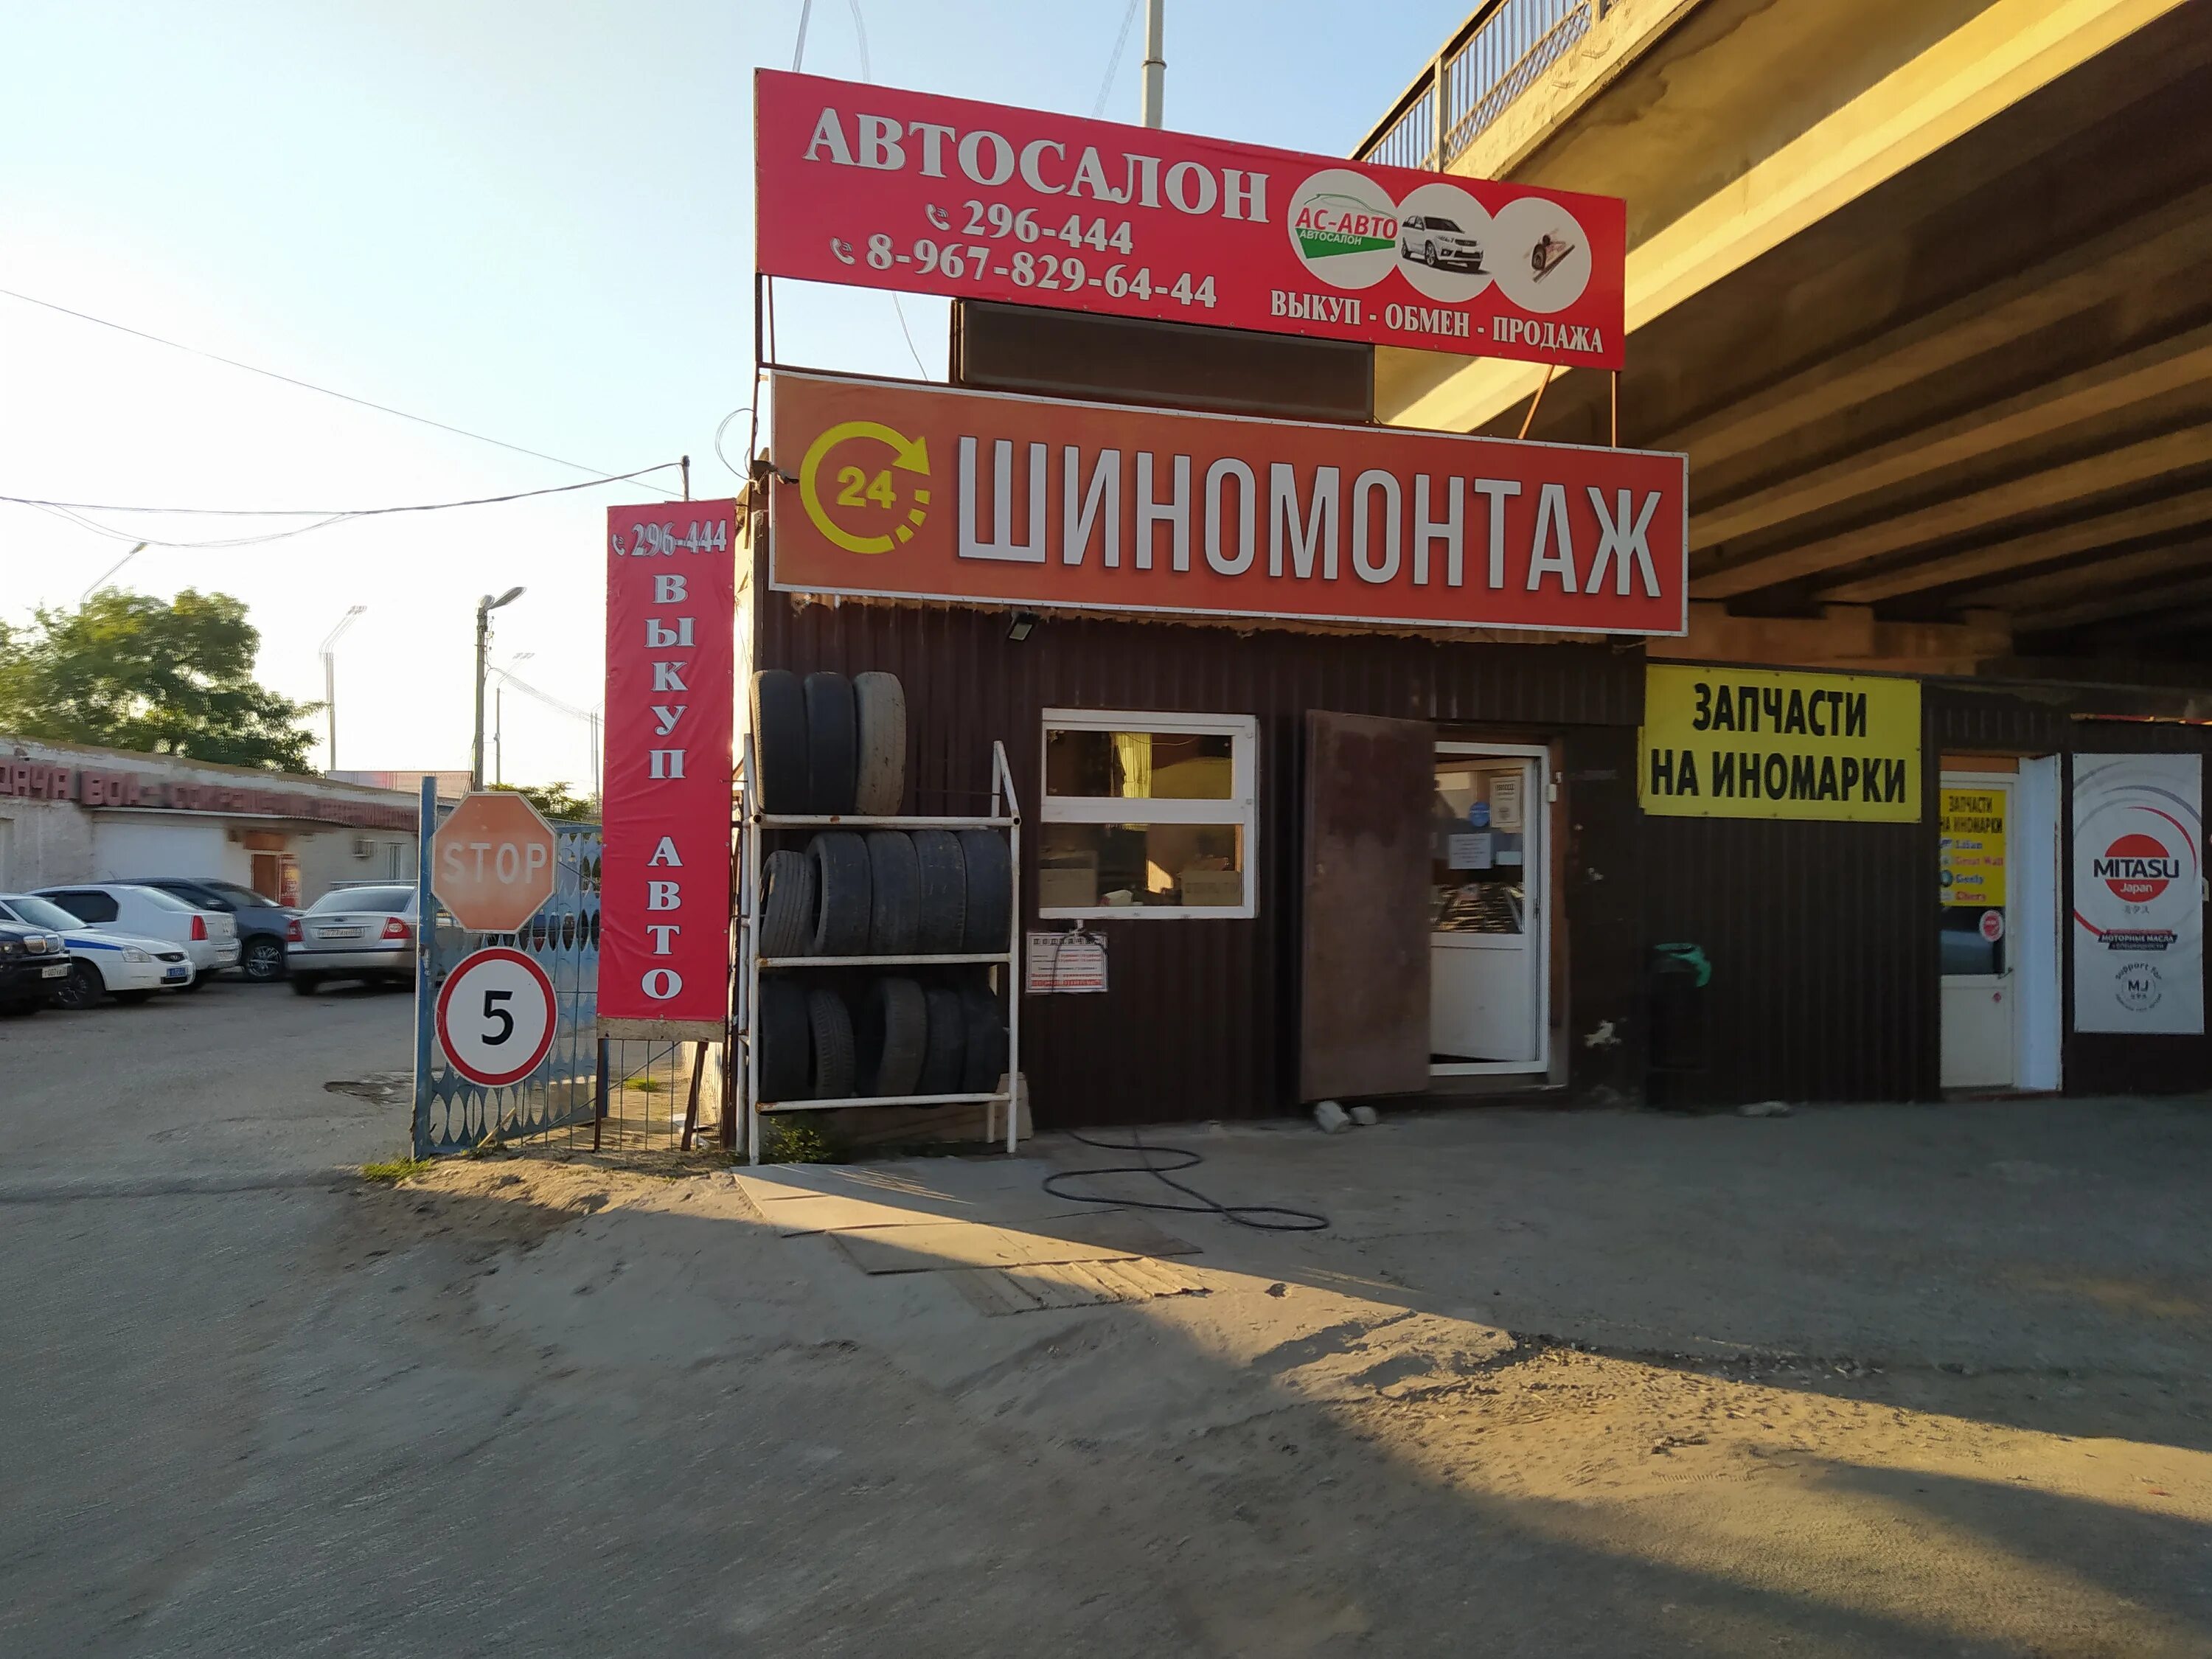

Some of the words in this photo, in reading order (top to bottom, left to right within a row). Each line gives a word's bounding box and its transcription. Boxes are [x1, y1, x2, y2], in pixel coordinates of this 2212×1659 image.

[803, 106, 1270, 223] АВТОСАЛОН
[961, 200, 1134, 255] 296-444
[1295, 207, 1398, 239] АС-АВТО
[1299, 230, 1362, 246] АВТОСАЛОН
[866, 233, 1217, 308] 8-967-829-64-44
[1271, 291, 1360, 325] ВЫКУП
[1385, 303, 1470, 338] ОБМЕН
[1493, 316, 1603, 353] ПРОДАЖА
[835, 466, 896, 509] 24
[632, 519, 727, 557] 296-444
[957, 436, 1661, 597] ШИНОМОНТАЖ
[644, 574, 696, 779] ВЫКУП
[1693, 683, 1866, 737] ЗАПЧАСТИ
[1651, 749, 1699, 796] НА
[1712, 751, 1905, 803] ИНОМАРКИ
[1949, 796, 1993, 813] ЗАПЧАСТИ
[1954, 817, 2003, 834] ИНОМАРКИ
[442, 843, 547, 885] STOP
[2094, 859, 2180, 878] MITASU
[2120, 883, 2153, 894] Japan
[641, 836, 683, 1000] АВТО
[2128, 980, 2149, 992] MJ
[481, 990, 514, 1046] 5
